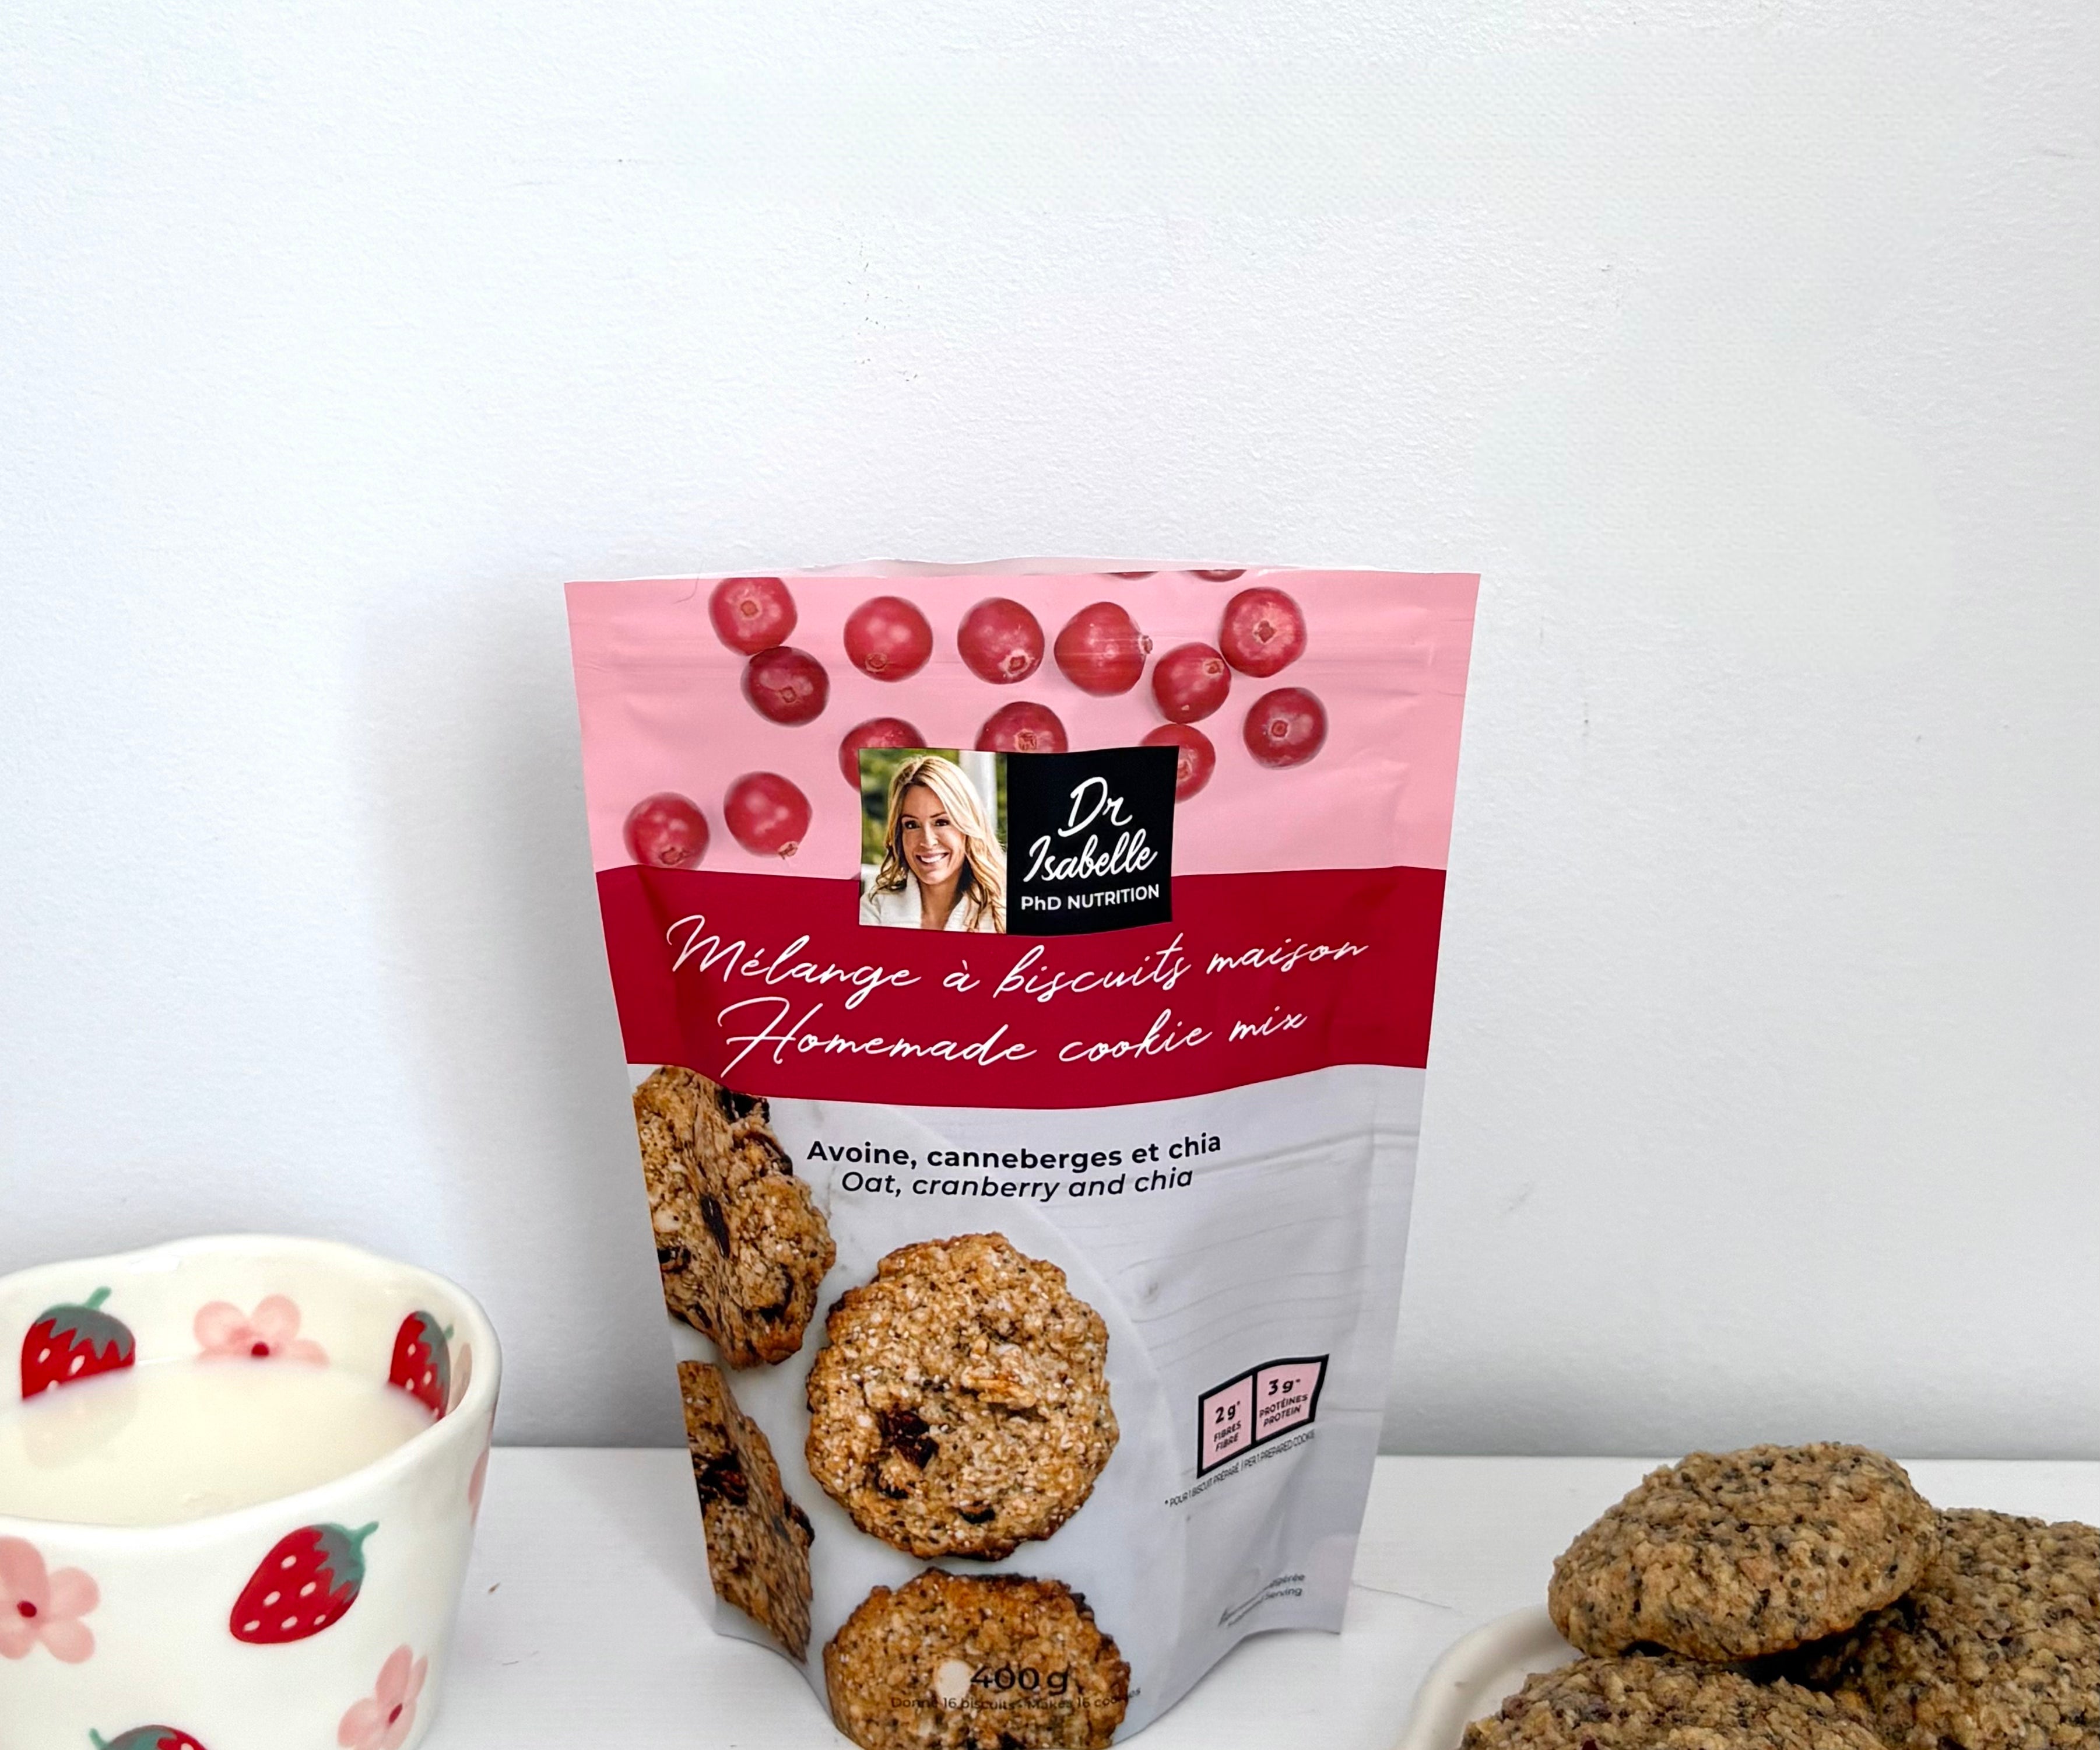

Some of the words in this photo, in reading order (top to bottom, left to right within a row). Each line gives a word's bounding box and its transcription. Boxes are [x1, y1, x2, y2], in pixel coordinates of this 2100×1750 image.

[1058, 776, 1133, 837] Dr
[1023, 828, 1158, 883] Isabelle
[1021, 896, 1062, 911] PhD
[1067, 884, 1160, 909] NUTRITION
[666, 915, 922, 1009] Mélange
[943, 960, 981, 993] à
[993, 932, 1191, 1002] biscuits
[1206, 938, 1369, 974] maison
[717, 996, 1037, 1078] Homemade
[1058, 1008, 1213, 1062] cookie
[1228, 1005, 1308, 1042] mix
[807, 1141, 917, 1169] Avoine,
[927, 1147, 1122, 1173] canneberges
[1131, 1143, 1159, 1162] et
[1168, 1132, 1221, 1159] chia
[842, 1172, 902, 1197] Oat,
[912, 1176, 1060, 1202] cranberry
[1068, 1173, 1126, 1197] and
[1134, 1167, 1193, 1193] chia
[1259, 1394, 1308, 1418] PROTÉINES
[1263, 1405, 1301, 1427] PROTEIN
[1214, 1421, 1241, 1442] FIBRES
[1215, 1432, 1239, 1452] FIBRE
[970, 1665, 1040, 1690] 400
[1047, 1668, 1070, 1696] g
[943, 1697, 957, 1709] 16
[960, 1696, 1015, 1710] biscuits
[1077, 1697, 1091, 1709] 16
